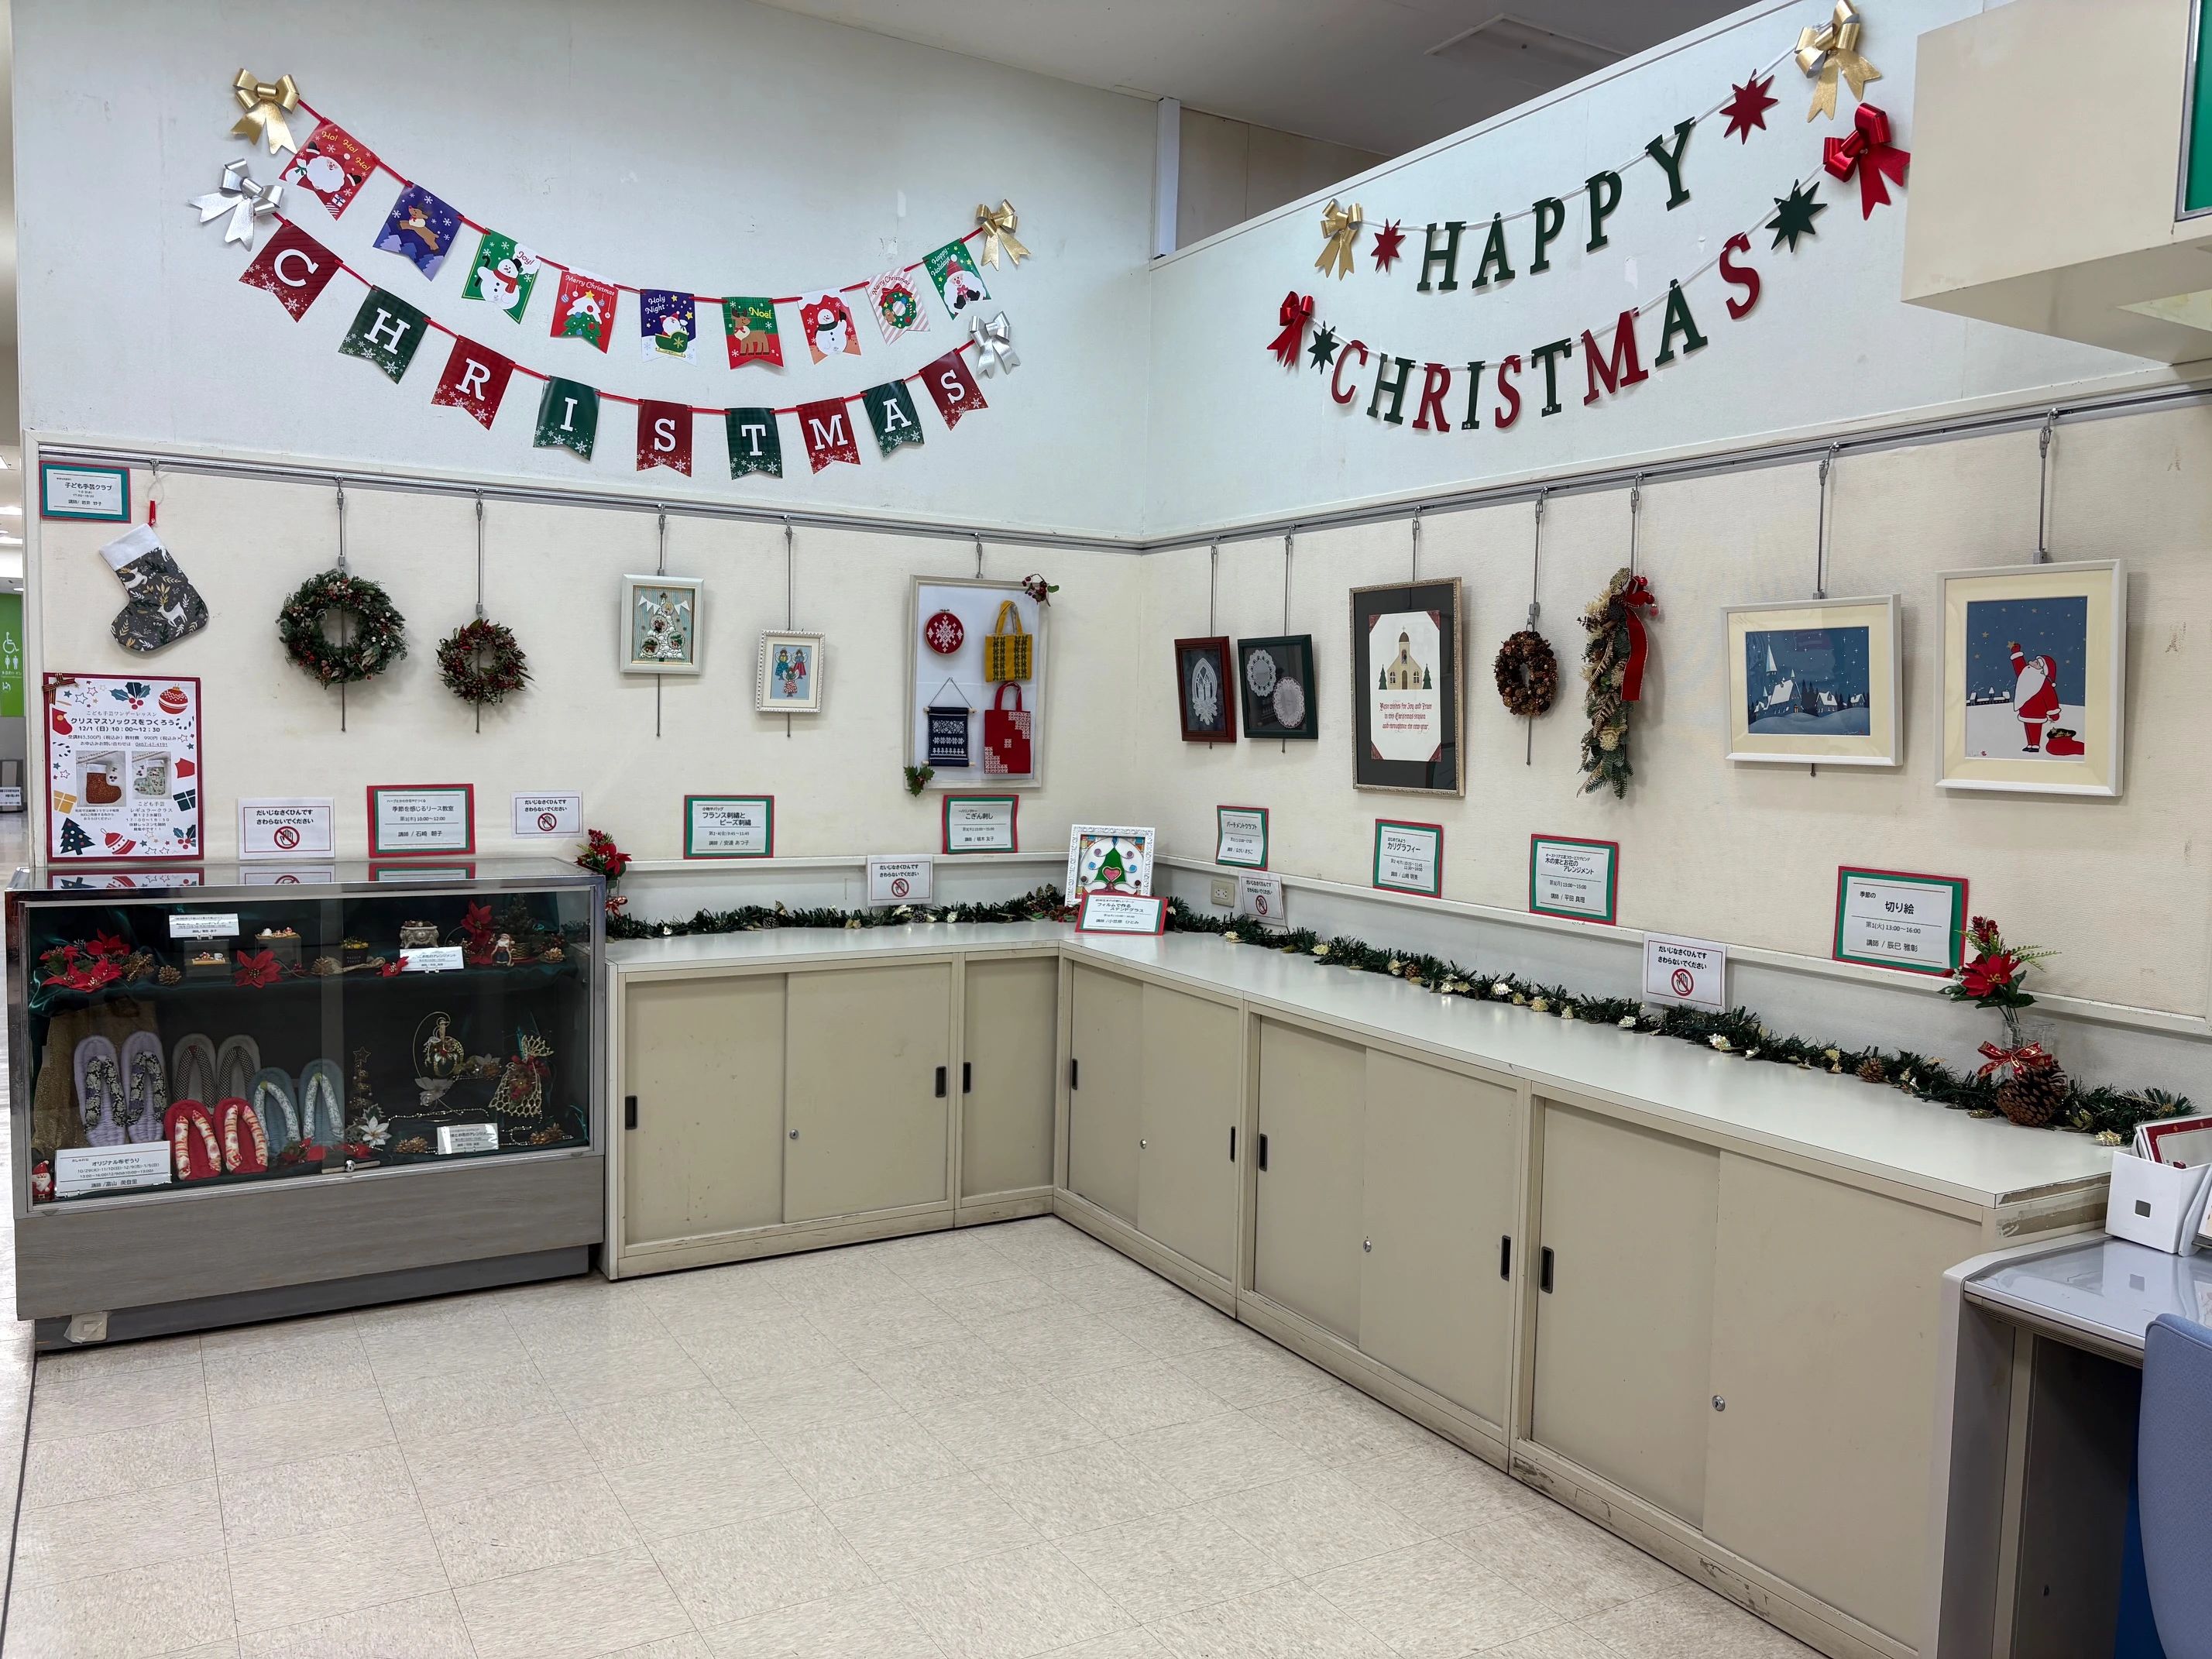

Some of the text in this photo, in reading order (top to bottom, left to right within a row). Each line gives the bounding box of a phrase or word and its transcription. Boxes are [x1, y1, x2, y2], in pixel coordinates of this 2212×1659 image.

[321, 130, 338, 142] Ho!
[342, 139, 359, 153] Ho!
[356, 156, 371, 171] Ho!
[1417, 116, 1696, 292] HAPPY
[517, 251, 535, 266] Joy!
[931, 248, 948, 265] Happy
[930, 256, 950, 276] Holidays
[565, 274, 615, 296] Merry Christmas
[871, 275, 911, 296] Merry Christmas
[647, 294, 666, 305] Holy
[644, 304, 665, 314] Night
[748, 307, 773, 319] Noël
[1331, 232, 1760, 434] CHRISTMAS
[70, 717, 175, 726] クリスマスソックスをつくろう
[1387, 842, 1421, 853] カリグラフィー
[1544, 857, 1578, 867] 木の実とお花の
[1563, 865, 1594, 875] アレンジメント
[1859, 891, 1877, 899] 季節の
[1884, 900, 1915, 915] 切り絵
[1866, 939, 1879, 947] 講師
[1658, 945, 1707, 960] だいじなさくひんです
[1657, 956, 1707, 970] さわらないでください
[91, 1157, 140, 1166] オリジナル布ぞうり
